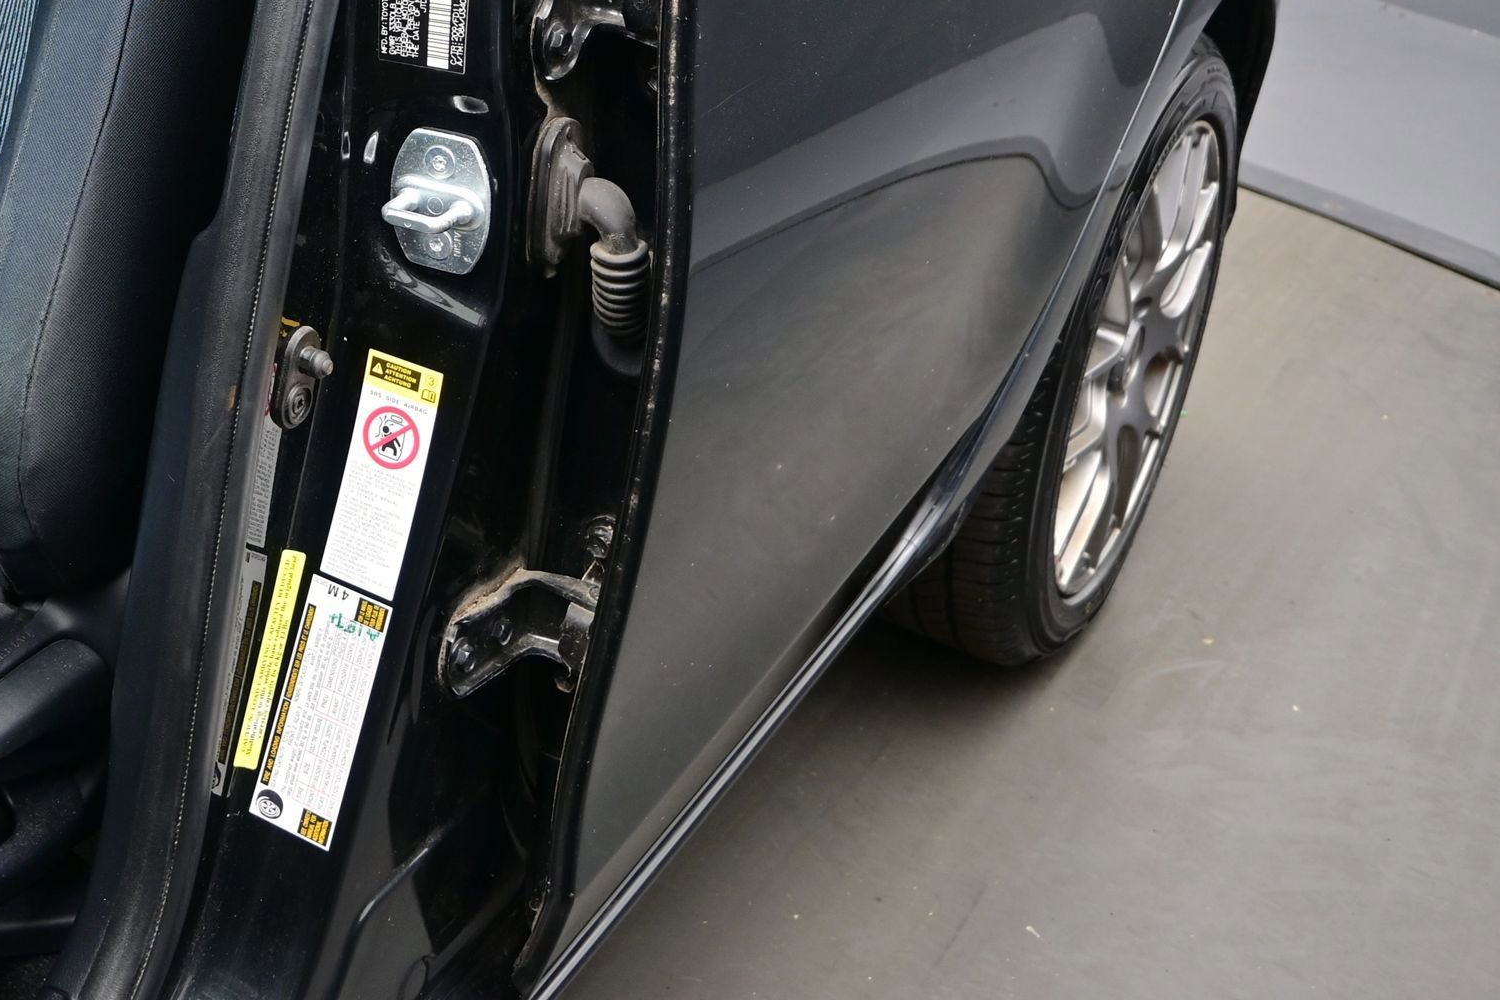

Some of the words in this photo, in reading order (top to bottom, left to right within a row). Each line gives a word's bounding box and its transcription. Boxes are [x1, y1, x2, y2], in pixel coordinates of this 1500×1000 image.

[413, 6, 420, 17] OF
[412, 20, 420, 40] DATE
[400, 26, 408, 57] FEDERAL
[411, 43, 419, 58] THE
[384, 367, 416, 384] ATTENTION
[385, 361, 411, 375] CAUTION
[383, 373, 411, 388] ACHTUNG
[369, 389, 382, 398] SRS
[385, 395, 399, 405] SIDE
[403, 401, 428, 416] AIRBAG
[275, 699, 289, 735] INFORMATION
[268, 733, 280, 758] LOADING
[265, 756, 274, 770] AND
[262, 769, 271, 783] TIRE
